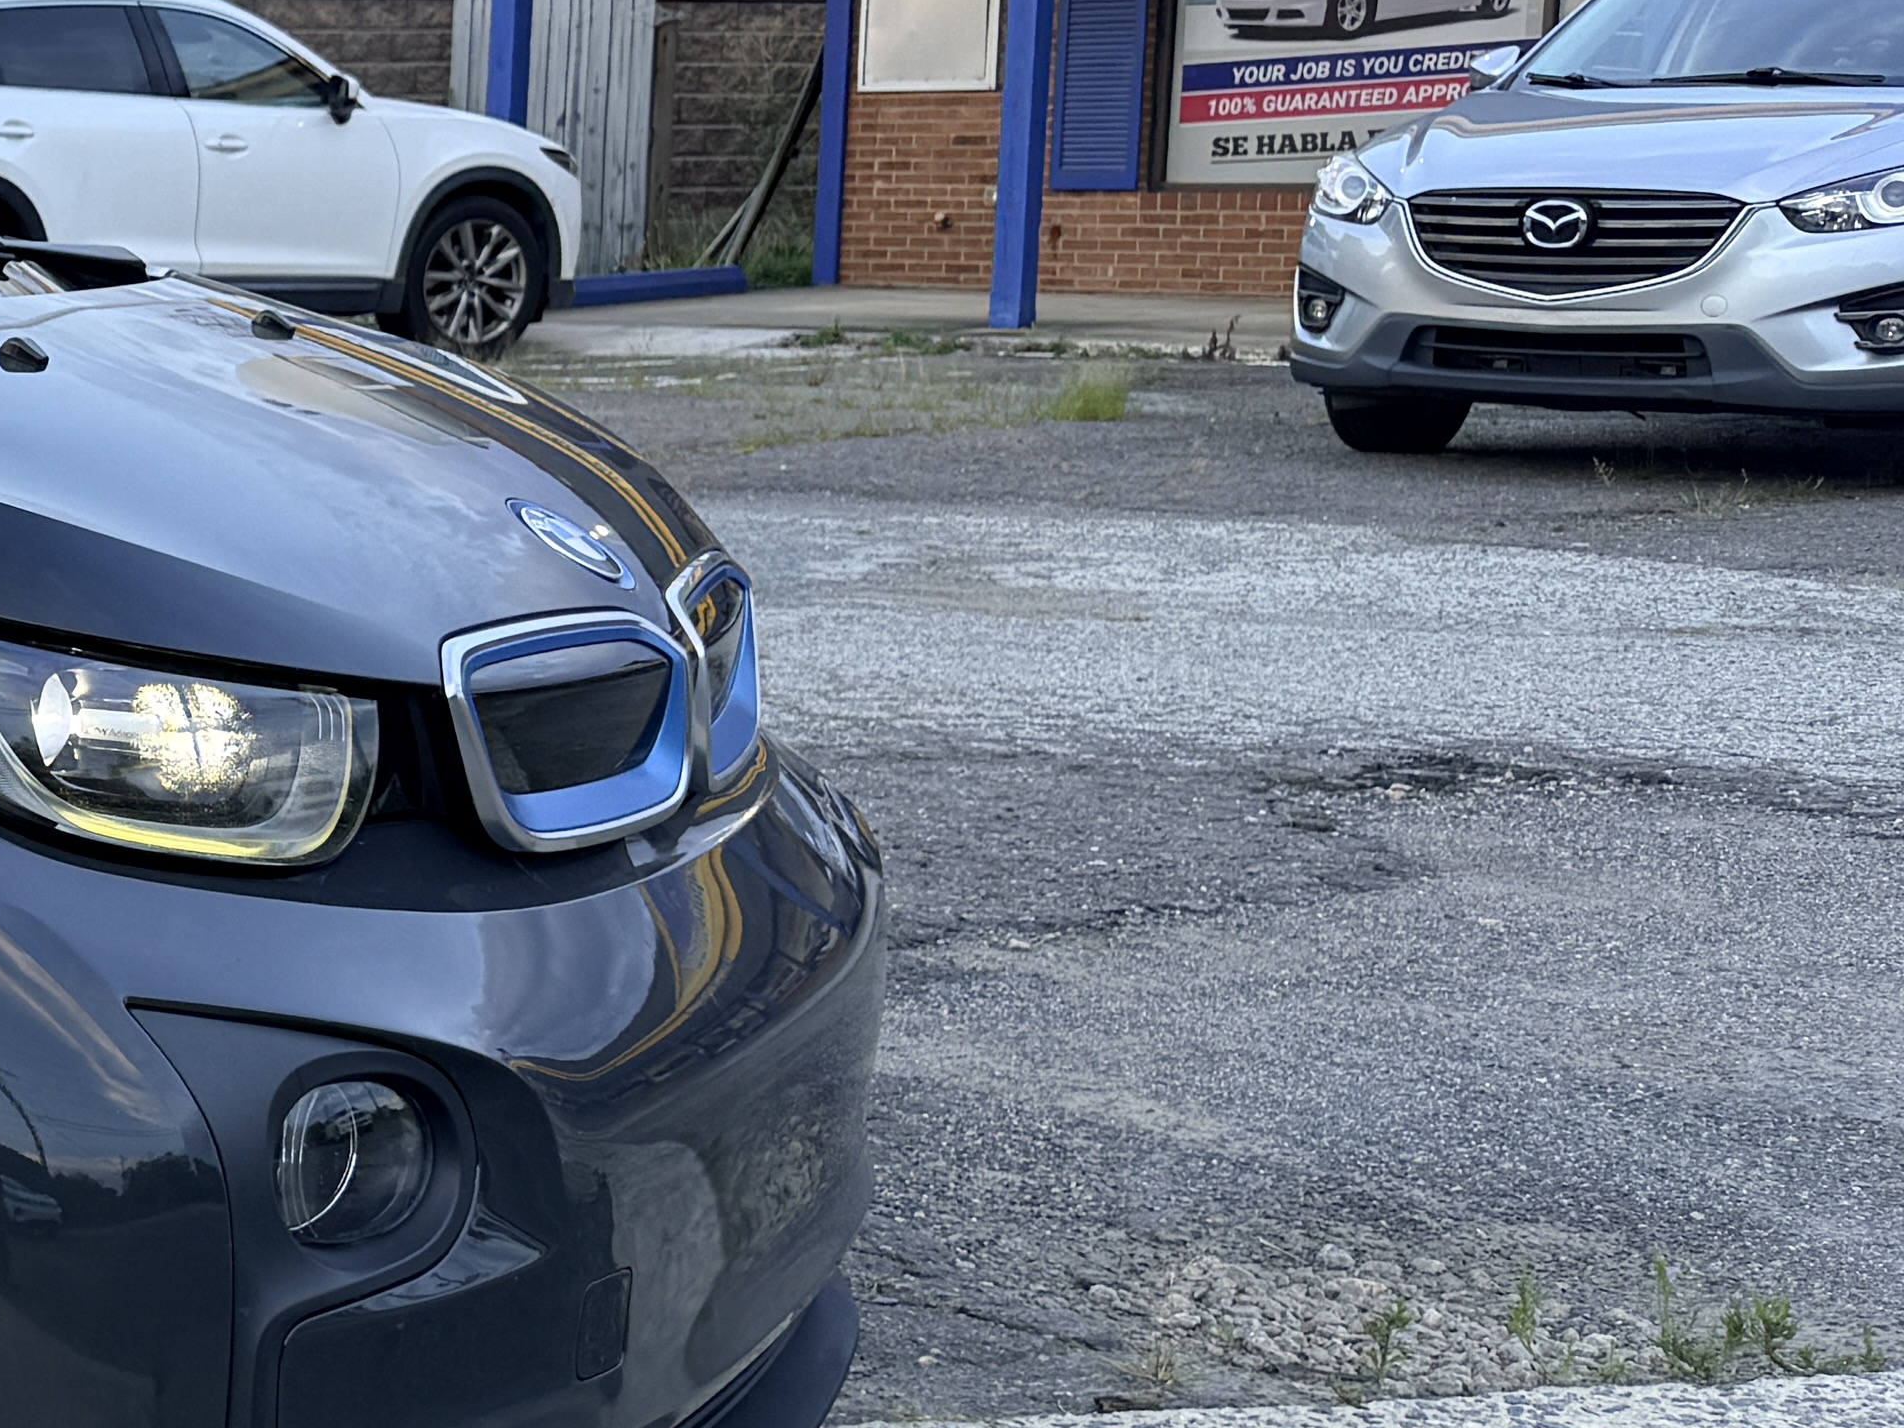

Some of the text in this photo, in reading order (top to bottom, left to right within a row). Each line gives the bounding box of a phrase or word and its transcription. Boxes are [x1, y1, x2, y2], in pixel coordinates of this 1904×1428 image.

[1232, 64, 1286, 85] YOUR
[1290, 60, 1331, 81] JOB
[1335, 58, 1357, 78] IS
[1362, 54, 1404, 75] YOU
[1207, 97, 1257, 117] 100%
[1262, 86, 1398, 113] GUARANTEED
[1211, 134, 1248, 158] SE
[1256, 130, 1357, 156] HABLA
